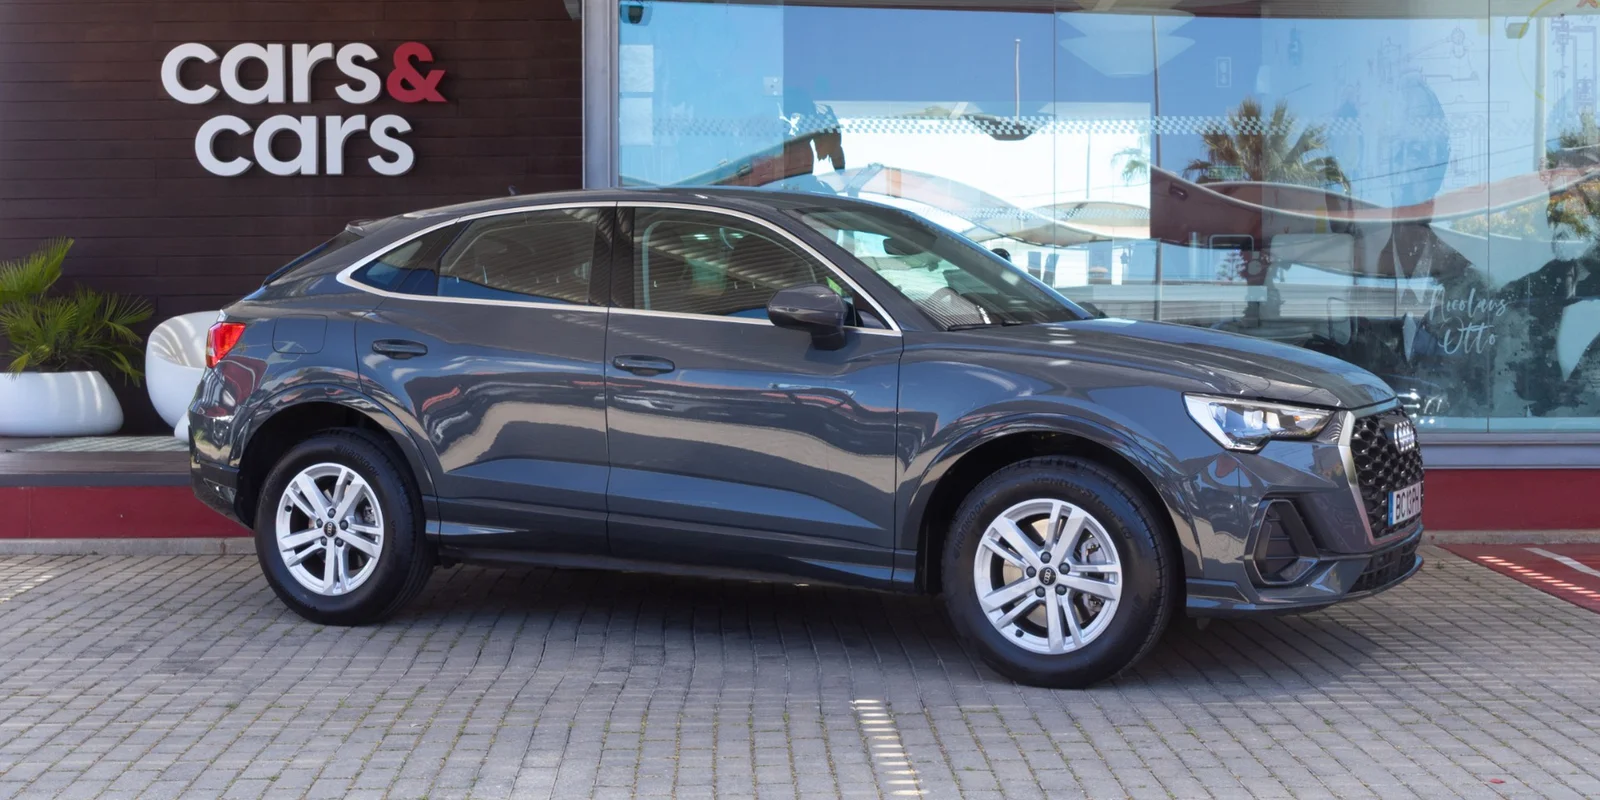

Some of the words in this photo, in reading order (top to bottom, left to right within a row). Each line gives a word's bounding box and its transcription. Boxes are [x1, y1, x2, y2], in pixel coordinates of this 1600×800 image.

[195, 114, 416, 176] cars
[1430, 284, 1509, 322] Nicolaus
[1438, 316, 1498, 354] Otto
